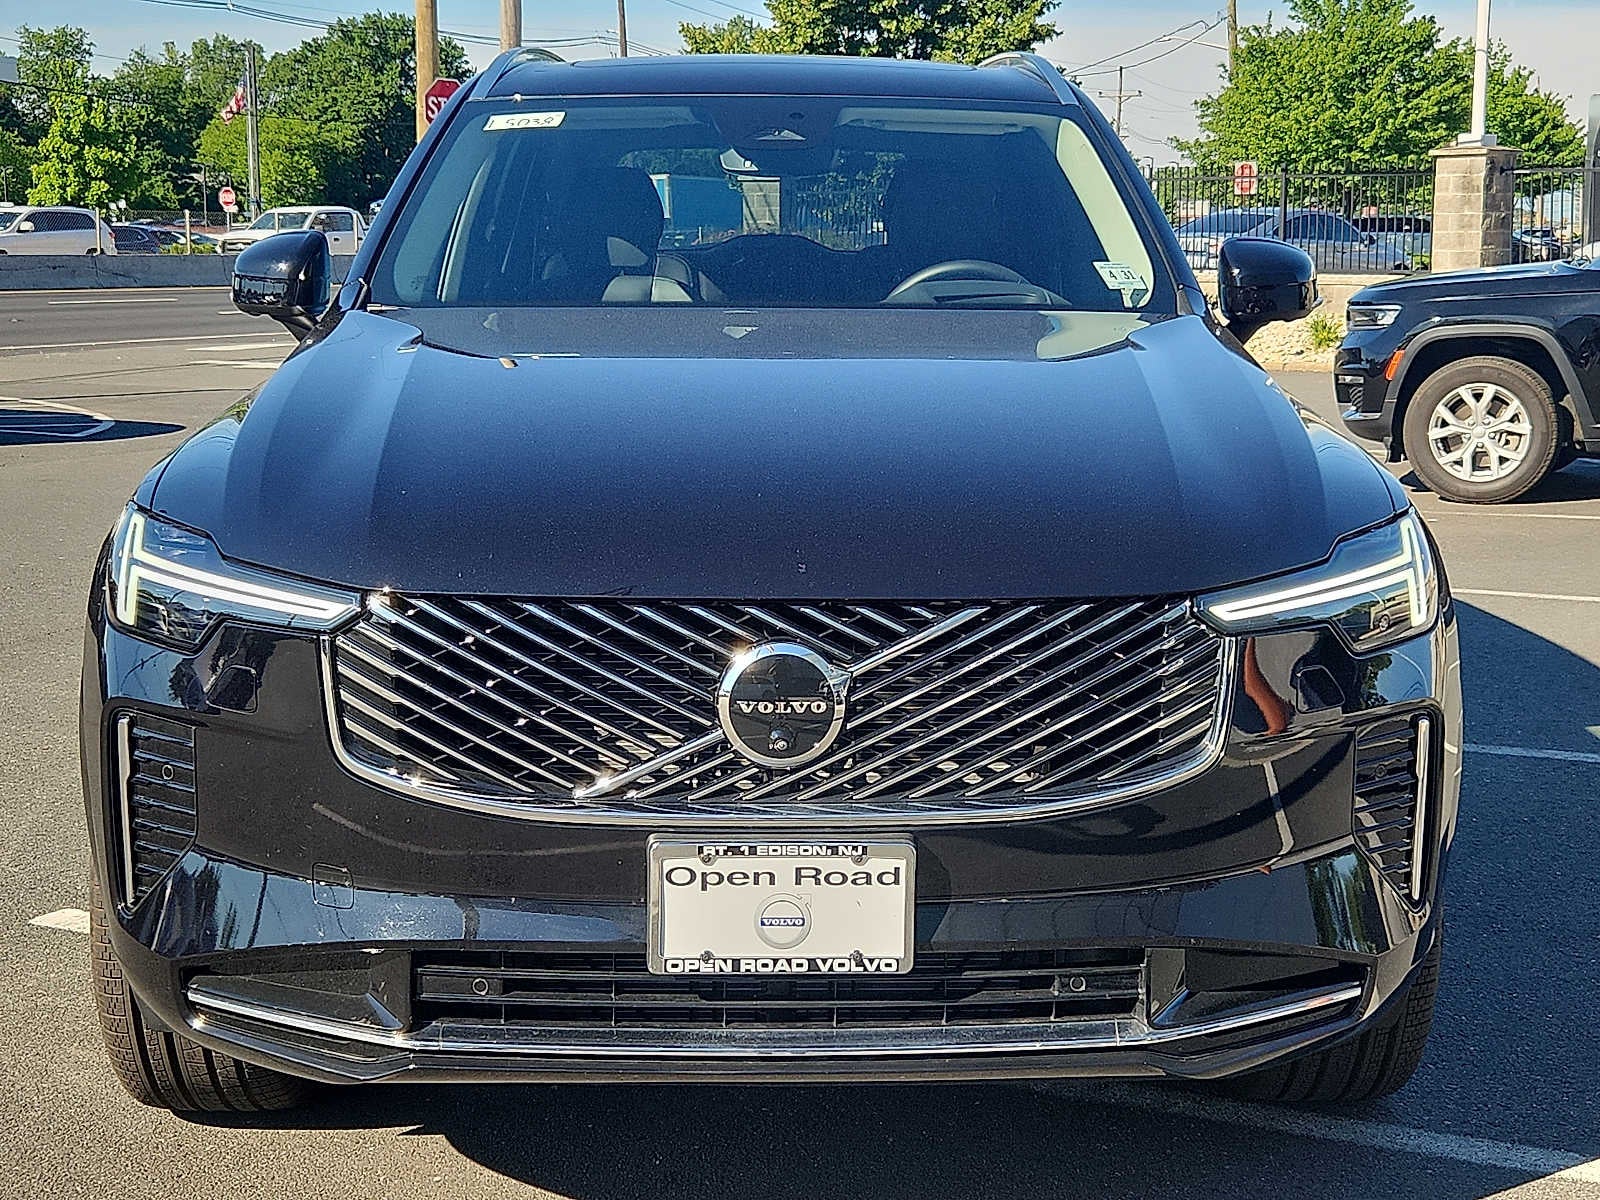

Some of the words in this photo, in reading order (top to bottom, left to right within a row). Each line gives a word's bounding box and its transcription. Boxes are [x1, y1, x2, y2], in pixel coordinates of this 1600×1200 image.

[427, 95, 448, 119] ST
[1109, 270, 1118, 280] 4
[736, 700, 828, 714] VOLVO
[703, 845, 733, 857] RT.
[740, 845, 750, 856] 1
[838, 845, 863, 856] NJ
[665, 866, 776, 892] Open
[794, 866, 901, 886] Road
[761, 917, 805, 926] VOLVO
[665, 958, 732, 973] OPEN
[739, 958, 809, 973] ROAD
[815, 958, 899, 973] VOLVO
